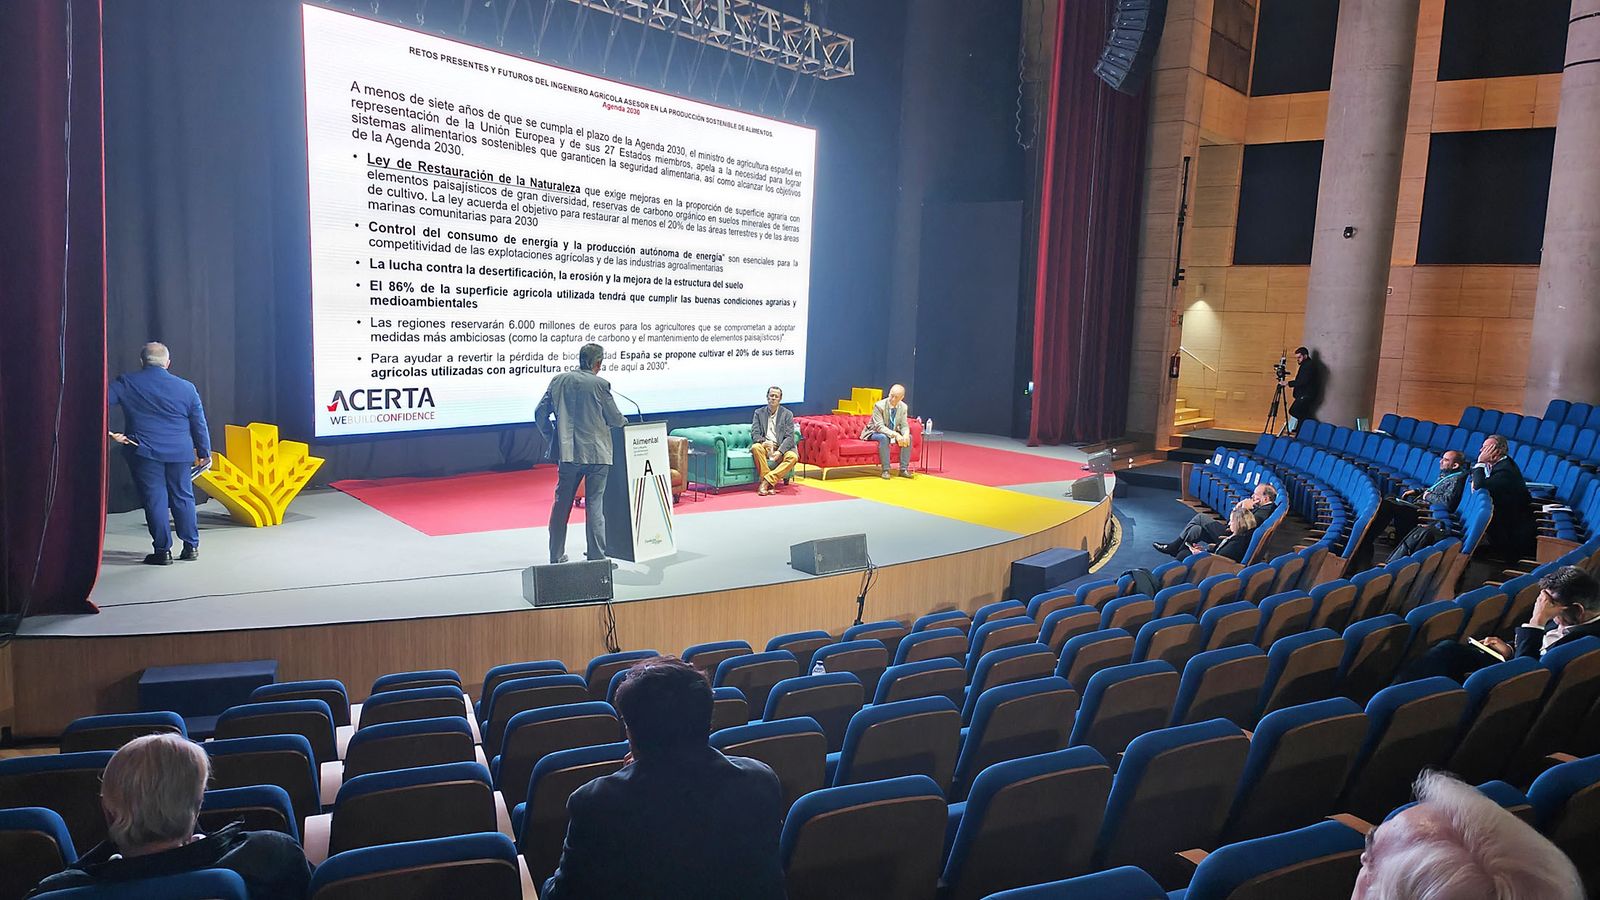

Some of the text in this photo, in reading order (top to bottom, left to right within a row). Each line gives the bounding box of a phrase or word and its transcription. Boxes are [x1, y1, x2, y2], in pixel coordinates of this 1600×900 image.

[409, 46, 438, 60] RETOS
[441, 54, 489, 72] PRESENTES
[498, 68, 533, 83] FUTUROS
[535, 77, 549, 87] DEL
[551, 81, 588, 96] INGENIERO
[624, 98, 649, 109] ASESOR
[650, 104, 658, 112] EN
[660, 106, 667, 114] LA
[350, 81, 610, 142] A menos de siete años de que se cumpla el plazo
[602, 102, 640, 115] Agenda 2030
[351, 99, 600, 152] representación de la Unión Europea y de sus
[352, 113, 606, 166] sistemas alimentarios sostenibles que garanticen
[352, 128, 464, 156] de la Agenda 2030.
[367, 152, 601, 197] Ley de Restauración de la Naturaleza que
[367, 169, 589, 208] elementos paisajísticos de gran diversidad,
[367, 184, 580, 219] de cultivo. La ley acuerda el objetivo para
[368, 201, 538, 227] marinas comunitarias para 2030
[369, 221, 582, 251] Control del consumo de energía y la
[369, 239, 601, 266] competitividad de las explotaciones agrícolas y
[370, 258, 743, 289] La lucha contra la desertificación, la erosión y la mejora de la estructura del suelo
[370, 280, 382, 291] El
[389, 281, 414, 293] 86%
[420, 283, 434, 293] de
[441, 284, 450, 294] la
[456, 286, 508, 297] superficie
[513, 288, 552, 299] agrícola
[557, 290, 595, 299] utilizada
[599, 291, 626, 301] tendrá
[630, 294, 645, 303] que
[648, 294, 678, 304] cumplir
[681, 295, 691, 303] las
[695, 296, 720, 304] buenas
[724, 297, 763, 306] condiciones
[766, 299, 790, 308] agrarias
[370, 296, 478, 308] medioambientales
[371, 317, 590, 330] Las regiones reservarán 6.000 millones de
[371, 332, 596, 344] medidas más ambiciosas (como la captura de
[371, 353, 398, 363] Para
[404, 353, 442, 365] ayudar
[458, 353, 493, 362] revertir
[497, 353, 505, 361] la
[510, 352, 544, 363] pérdida
[548, 352, 559, 361] de
[620, 351, 650, 361] España
[665, 352, 696, 360] propone
[699, 350, 725, 358] cultivar
[735, 349, 749, 357] 20%
[371, 367, 427, 380] agrícolas
[431, 366, 483, 376] utilizadas
[487, 367, 505, 375] con
[509, 364, 561, 376] agricultura
[327, 387, 436, 412] ACERTA
[632, 437, 659, 446] Alimental
[644, 459, 654, 476] A
